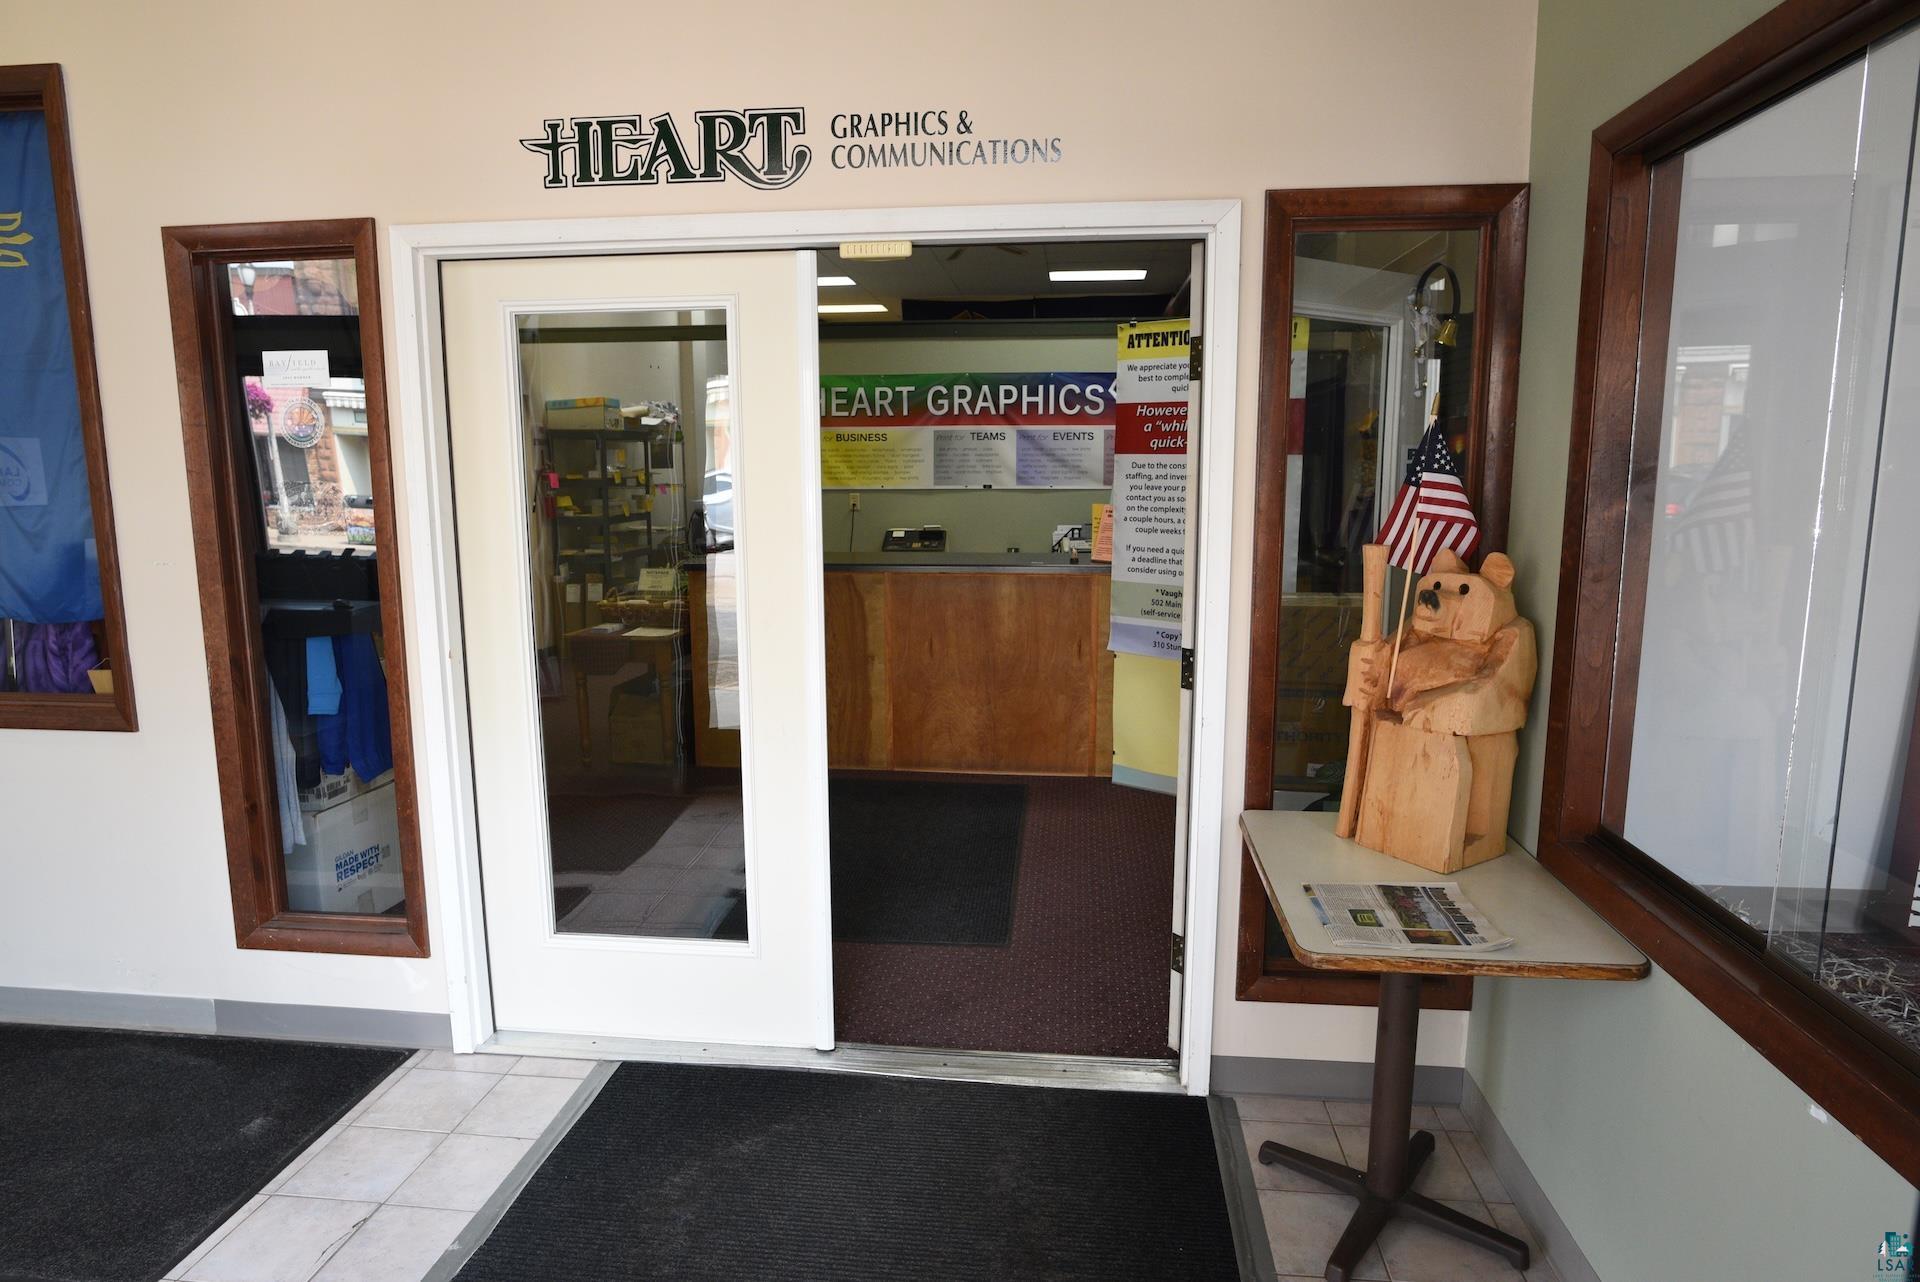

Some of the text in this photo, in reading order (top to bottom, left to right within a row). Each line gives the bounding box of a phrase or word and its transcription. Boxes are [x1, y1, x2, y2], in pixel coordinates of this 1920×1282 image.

[830, 110, 973, 138] GRAPHICS &
[519, 107, 811, 190] HEART
[831, 138, 1062, 169] COMMUNICATIONS
[1140, 362, 1177, 372] appreciate
[1138, 374, 1154, 382] best
[926, 384, 1105, 416] GRAPHICS
[1144, 423, 1152, 432] a
[836, 433, 888, 442] BUSINESS
[970, 432, 1006, 440] TEAMS
[1052, 432, 1094, 440] EVENTS
[1129, 515, 1152, 524] couple
[1136, 526, 1158, 534] couple
[1137, 556, 1168, 564] deadline
[1168, 557, 1182, 566] that
[1127, 566, 1156, 574] consider
[1158, 568, 1176, 578] using
[1165, 600, 1182, 608] Main
[1160, 632, 1178, 642] Copy
[1152, 640, 1165, 648] 310
[336, 844, 380, 872] MADE WITH
[336, 853, 380, 882] RESPECT
